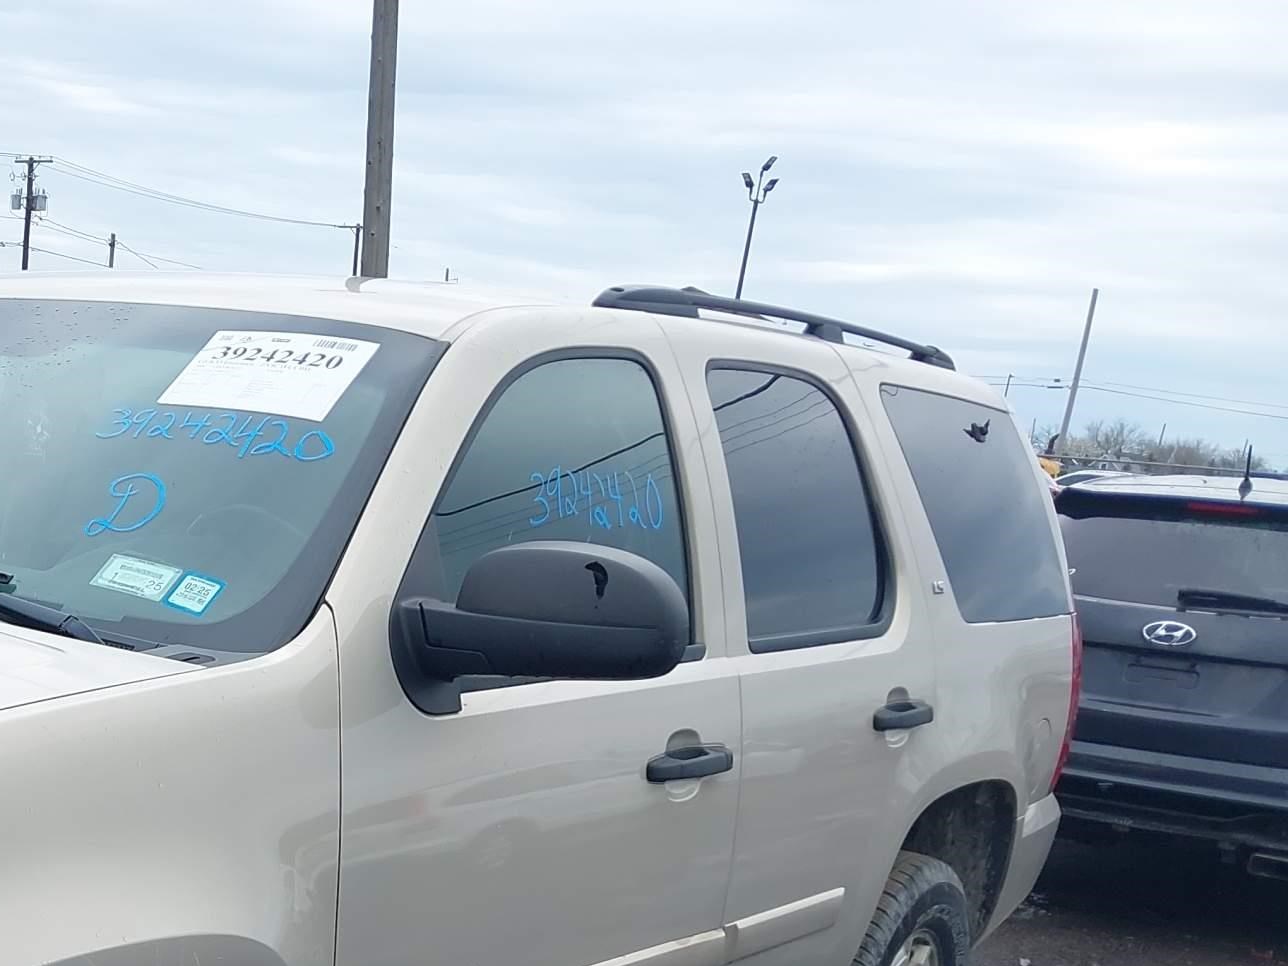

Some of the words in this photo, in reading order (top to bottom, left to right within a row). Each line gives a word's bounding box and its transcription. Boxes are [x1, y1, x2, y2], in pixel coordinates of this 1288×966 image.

[212, 346, 344, 370] 39242420
[96, 408, 335, 461] 39242420
[84, 473, 167, 536] D
[529, 465, 662, 529] 39242420
